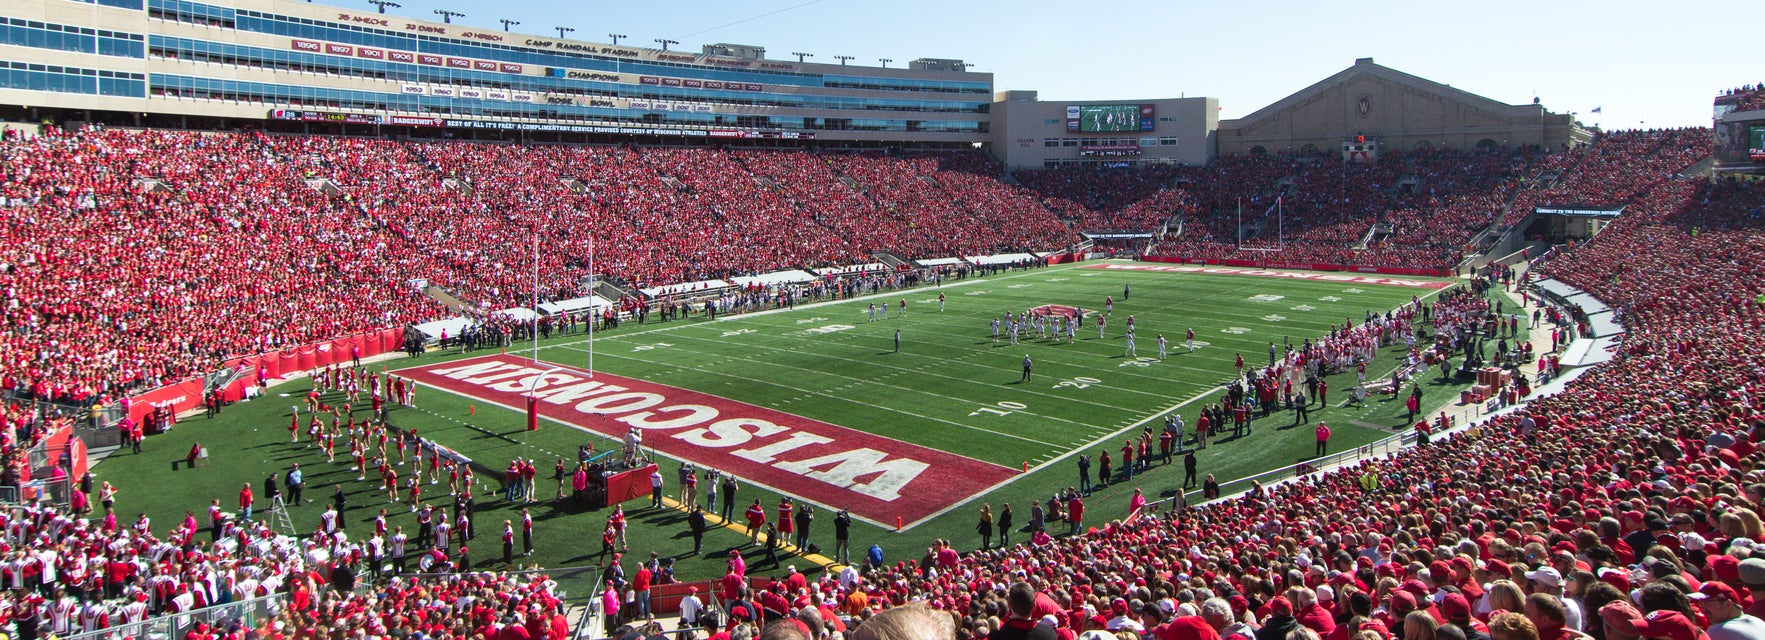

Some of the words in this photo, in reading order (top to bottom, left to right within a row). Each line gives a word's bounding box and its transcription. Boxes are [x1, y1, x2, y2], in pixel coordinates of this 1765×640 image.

[352, 16, 388, 26] AMECHE
[418, 25, 446, 34] DAYNE
[474, 33, 502, 41] HIRSCH
[296, 42, 318, 50] 1896
[526, 39, 552, 47] CAMP
[556, 42, 597, 53] RANDALL
[601, 47, 639, 57] STADIUM
[363, 48, 380, 56] 1901
[392, 52, 412, 60] 1906
[450, 58, 468, 66] 1952
[568, 72, 619, 82] CHAMPIONS
[393, 118, 433, 126] BADGERWIFI
[1060, 376, 1102, 389] 20
[977, 401, 1027, 417] 10
[428, 360, 930, 502] WISCONSIN
